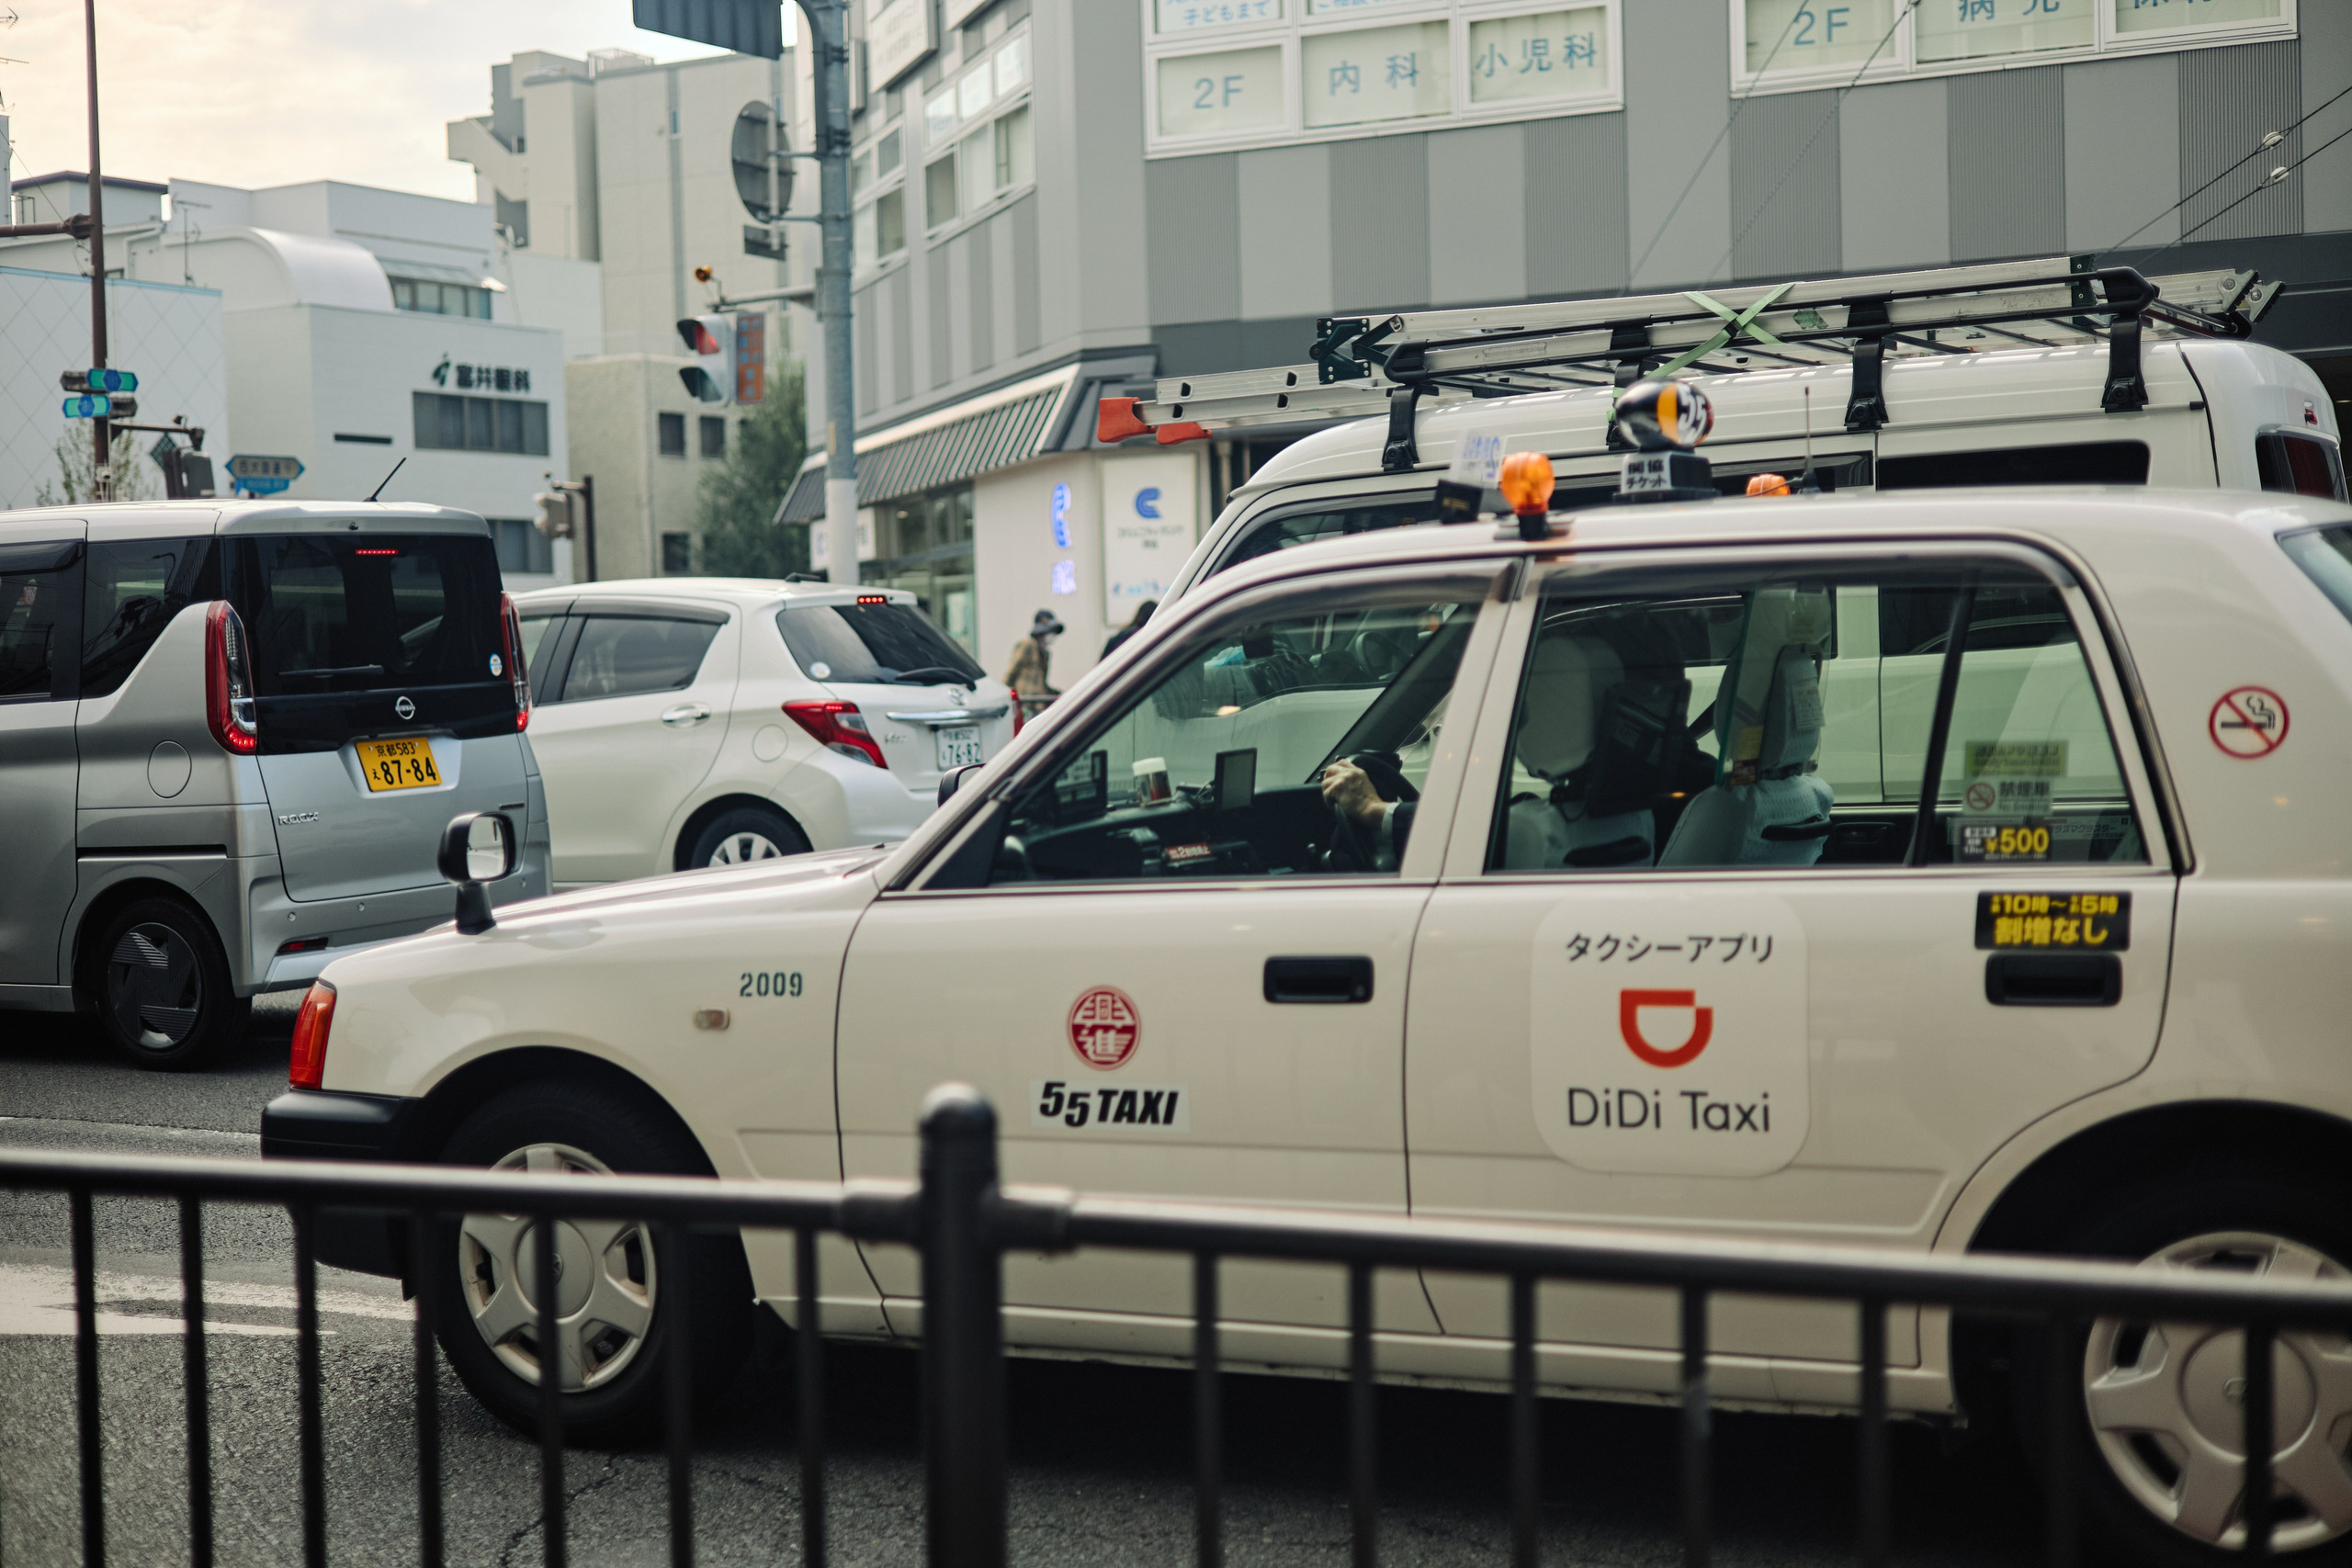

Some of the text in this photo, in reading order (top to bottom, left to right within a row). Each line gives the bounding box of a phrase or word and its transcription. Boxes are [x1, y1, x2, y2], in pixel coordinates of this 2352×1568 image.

[1792, 7, 1849, 46] 2F
[1193, 31, 1598, 109] 2F 内科 小児科
[1626, 474, 1668, 490] チケット
[380, 756, 436, 785] 87-84
[1995, 916, 2109, 946] 割増なし
[1566, 932, 1774, 964] タクシーアプリ
[740, 972, 803, 997] 2009
[1567, 1087, 1770, 1133] DiDi Taxi
